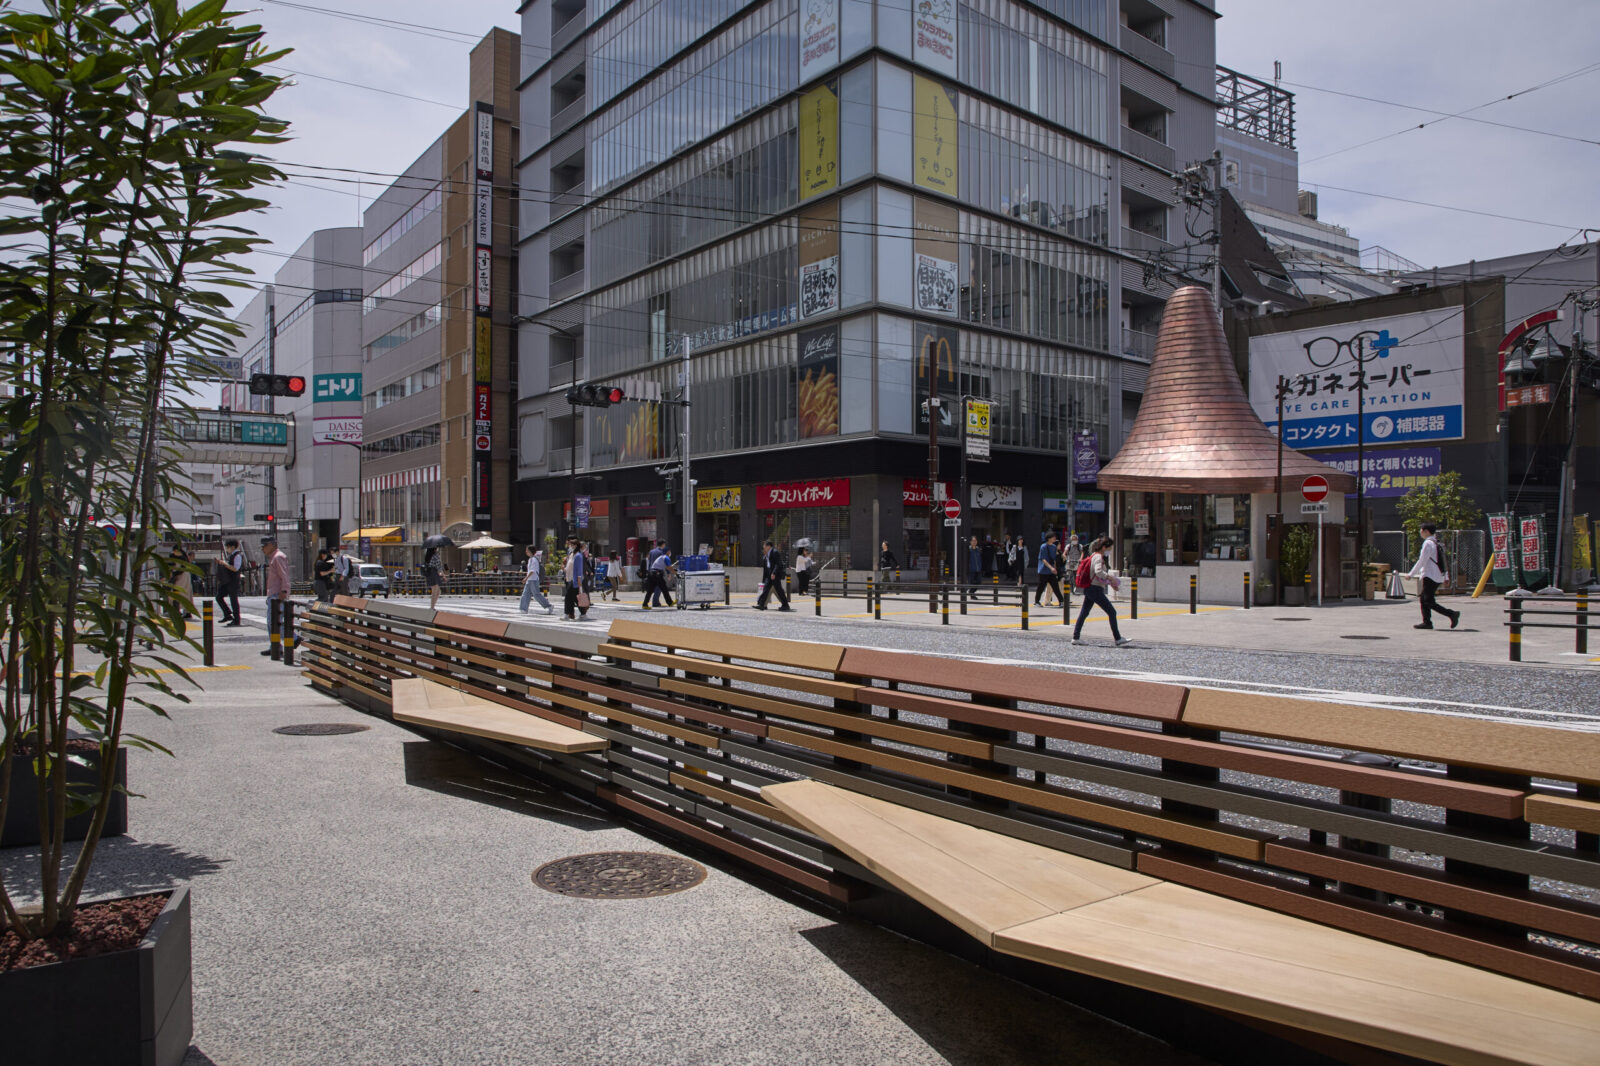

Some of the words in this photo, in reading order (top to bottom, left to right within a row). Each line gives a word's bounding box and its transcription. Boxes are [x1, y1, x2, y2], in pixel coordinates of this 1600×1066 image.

[318, 378, 355, 397] ニトリ
[1275, 363, 1431, 400] メガネスーパー
[1310, 399, 1349, 411] CARE
[1507, 387, 1548, 404] 二番街
[1287, 422, 1357, 441] コンタクト
[1395, 415, 1446, 434] 補聴器
[769, 486, 834, 504] タコとハイボール
[903, 491, 930, 502] タコとハ
[1490, 517, 1507, 568] 補聴器
[1522, 520, 1538, 570] 補聴器
